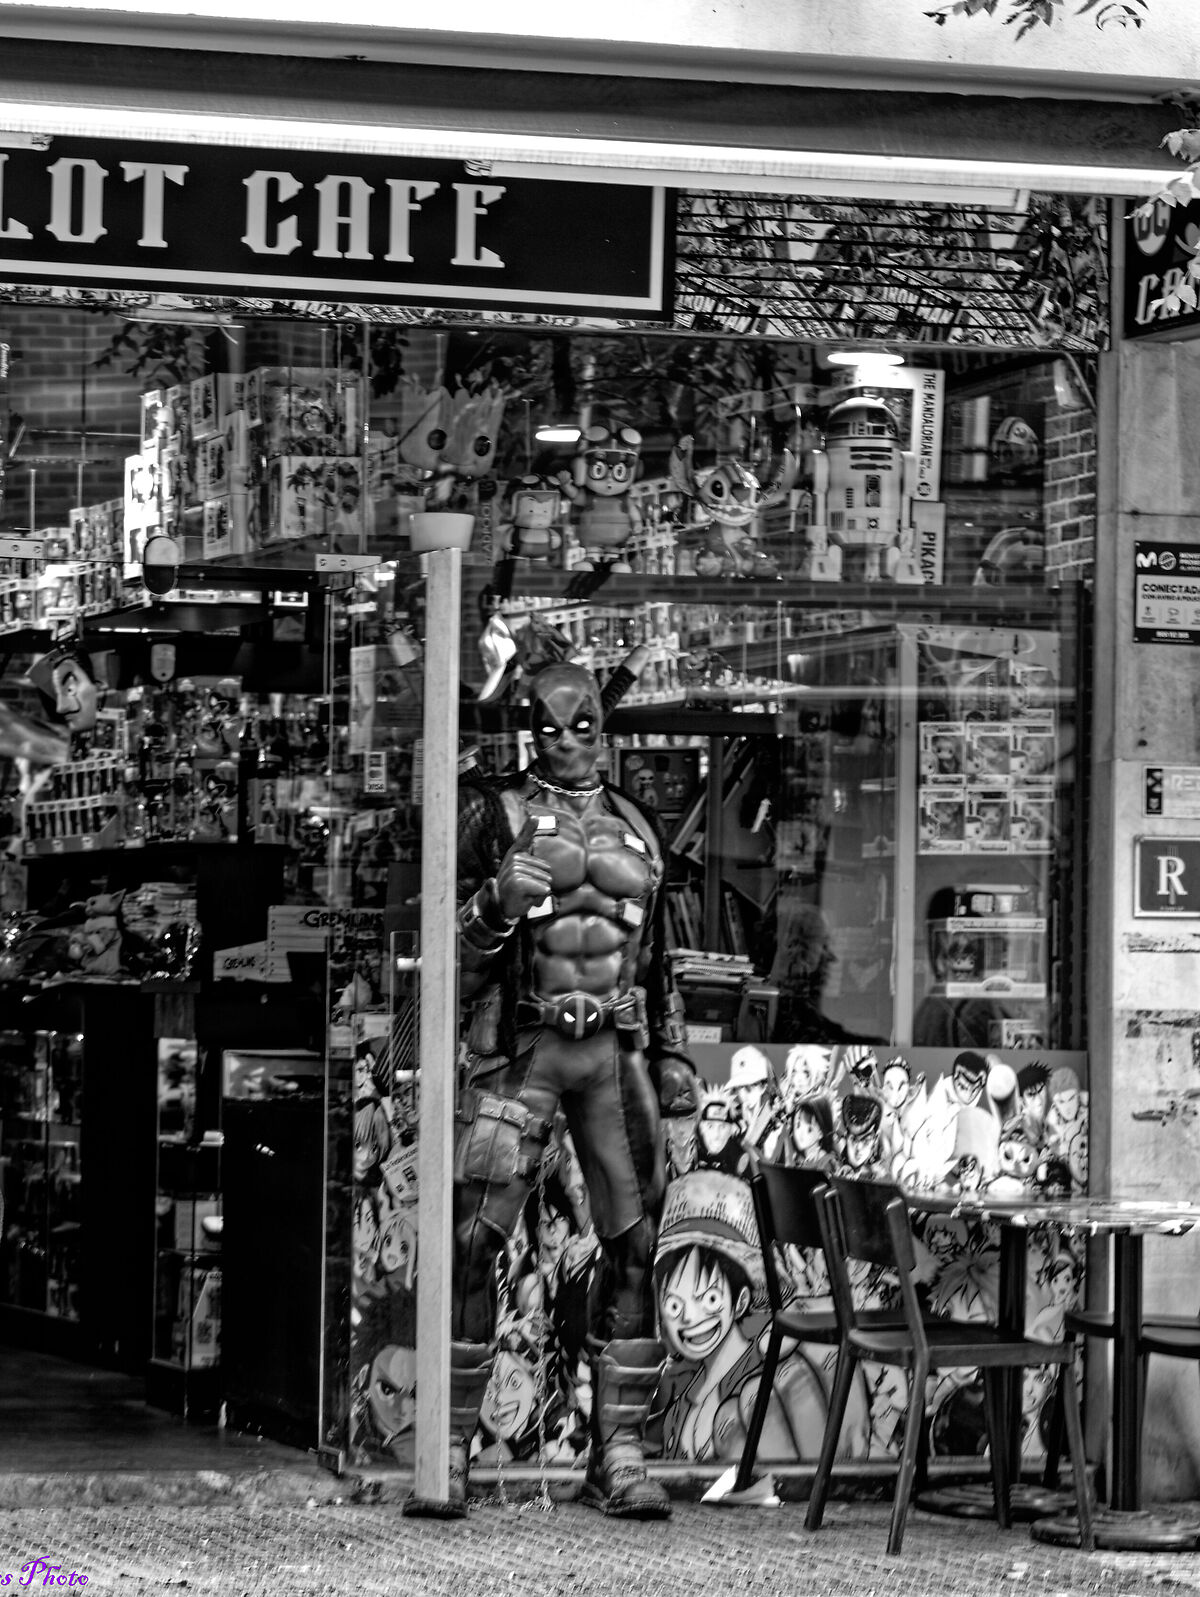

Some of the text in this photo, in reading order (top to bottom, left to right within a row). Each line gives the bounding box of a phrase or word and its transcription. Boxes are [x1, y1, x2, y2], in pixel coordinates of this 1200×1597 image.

[241, 169, 505, 268] CAFE
[922, 372, 937, 390] THE
[919, 392, 937, 457] MANDALORIAN
[1156, 856, 1188, 895] R
